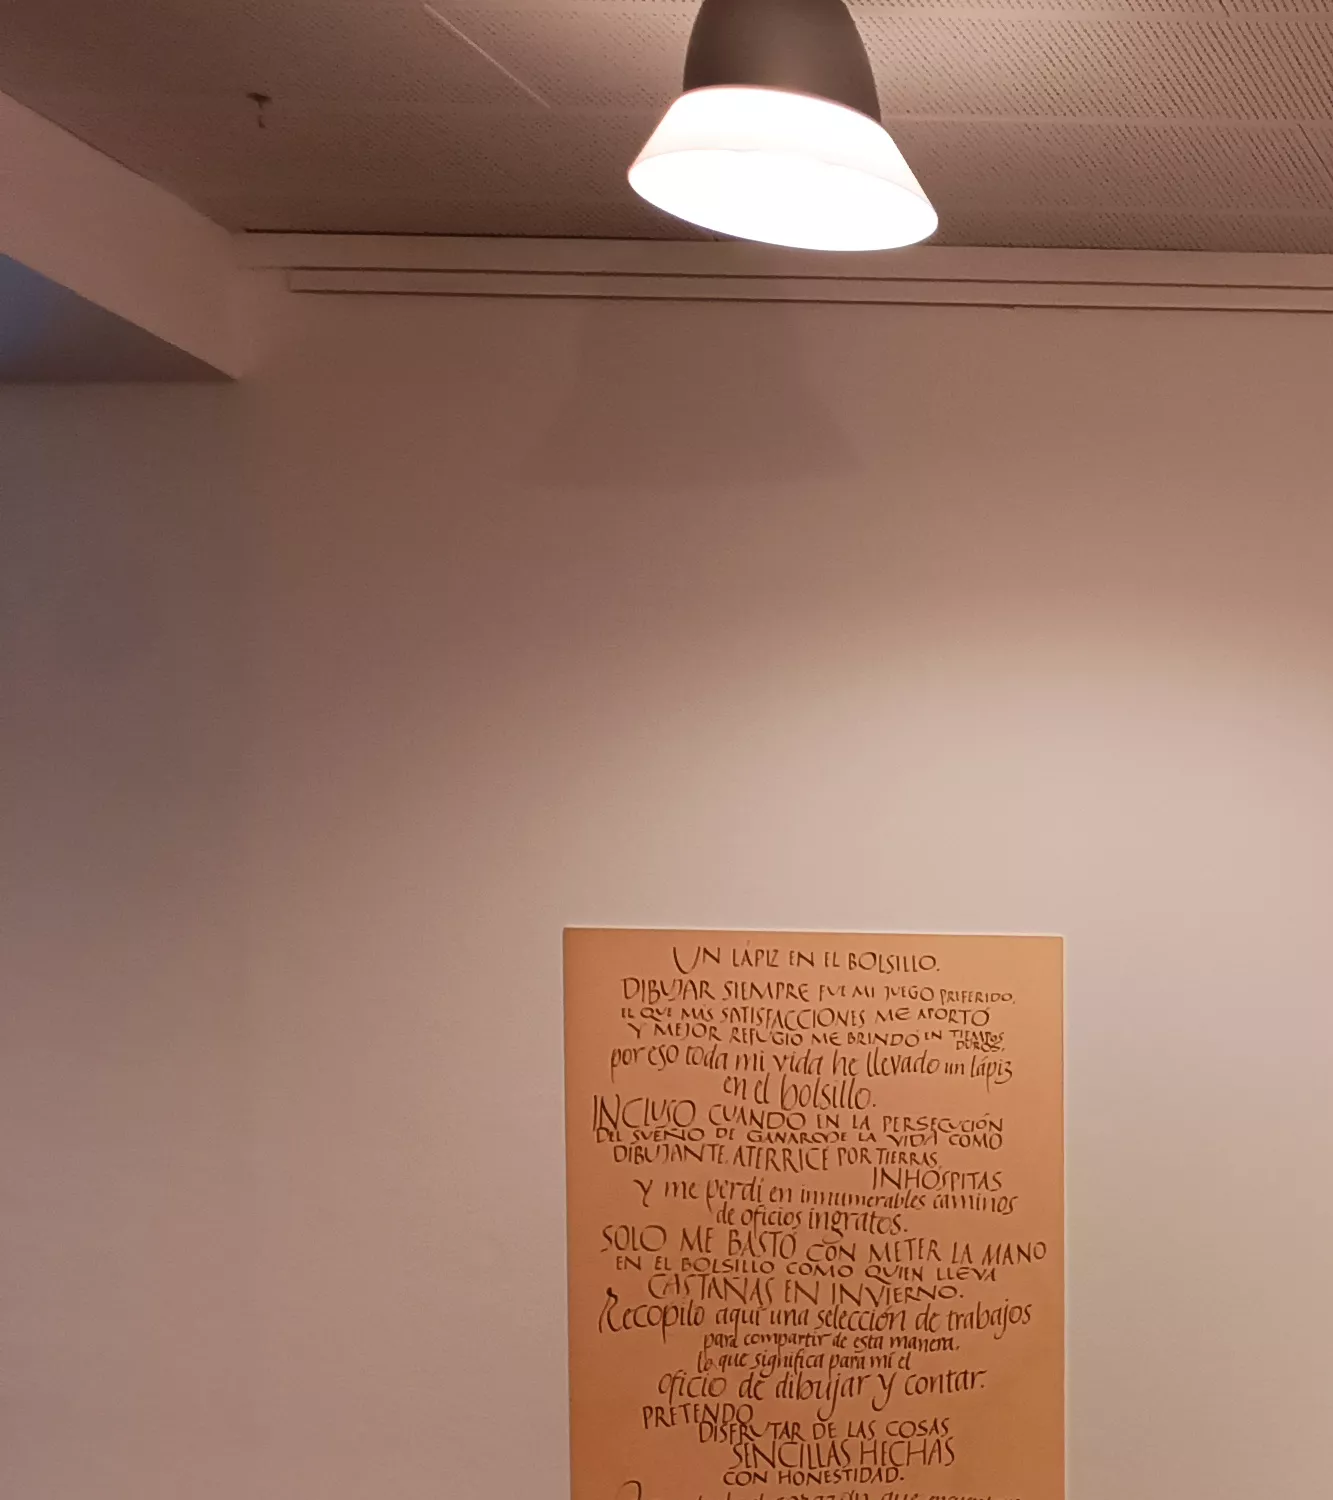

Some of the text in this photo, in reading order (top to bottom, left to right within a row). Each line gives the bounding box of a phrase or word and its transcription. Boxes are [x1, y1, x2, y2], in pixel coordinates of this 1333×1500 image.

[672, 939, 941, 974] UN LÁPIZ EN EL BOLSILLO.
[610, 1043, 1013, 1093] por eso toda mi vida he llevado un lápiz
[723, 1072, 877, 1110] en el bolsillo.
[600, 1225, 1047, 1266] SOLO ME BASTÓ CON METER LA MANO
[658, 1367, 987, 1422] oficio de dibujar y contar.
[729, 1437, 954, 1469] SENCILLAS HECHAS
[723, 1467, 904, 1486] CON HONESTIDAD.
